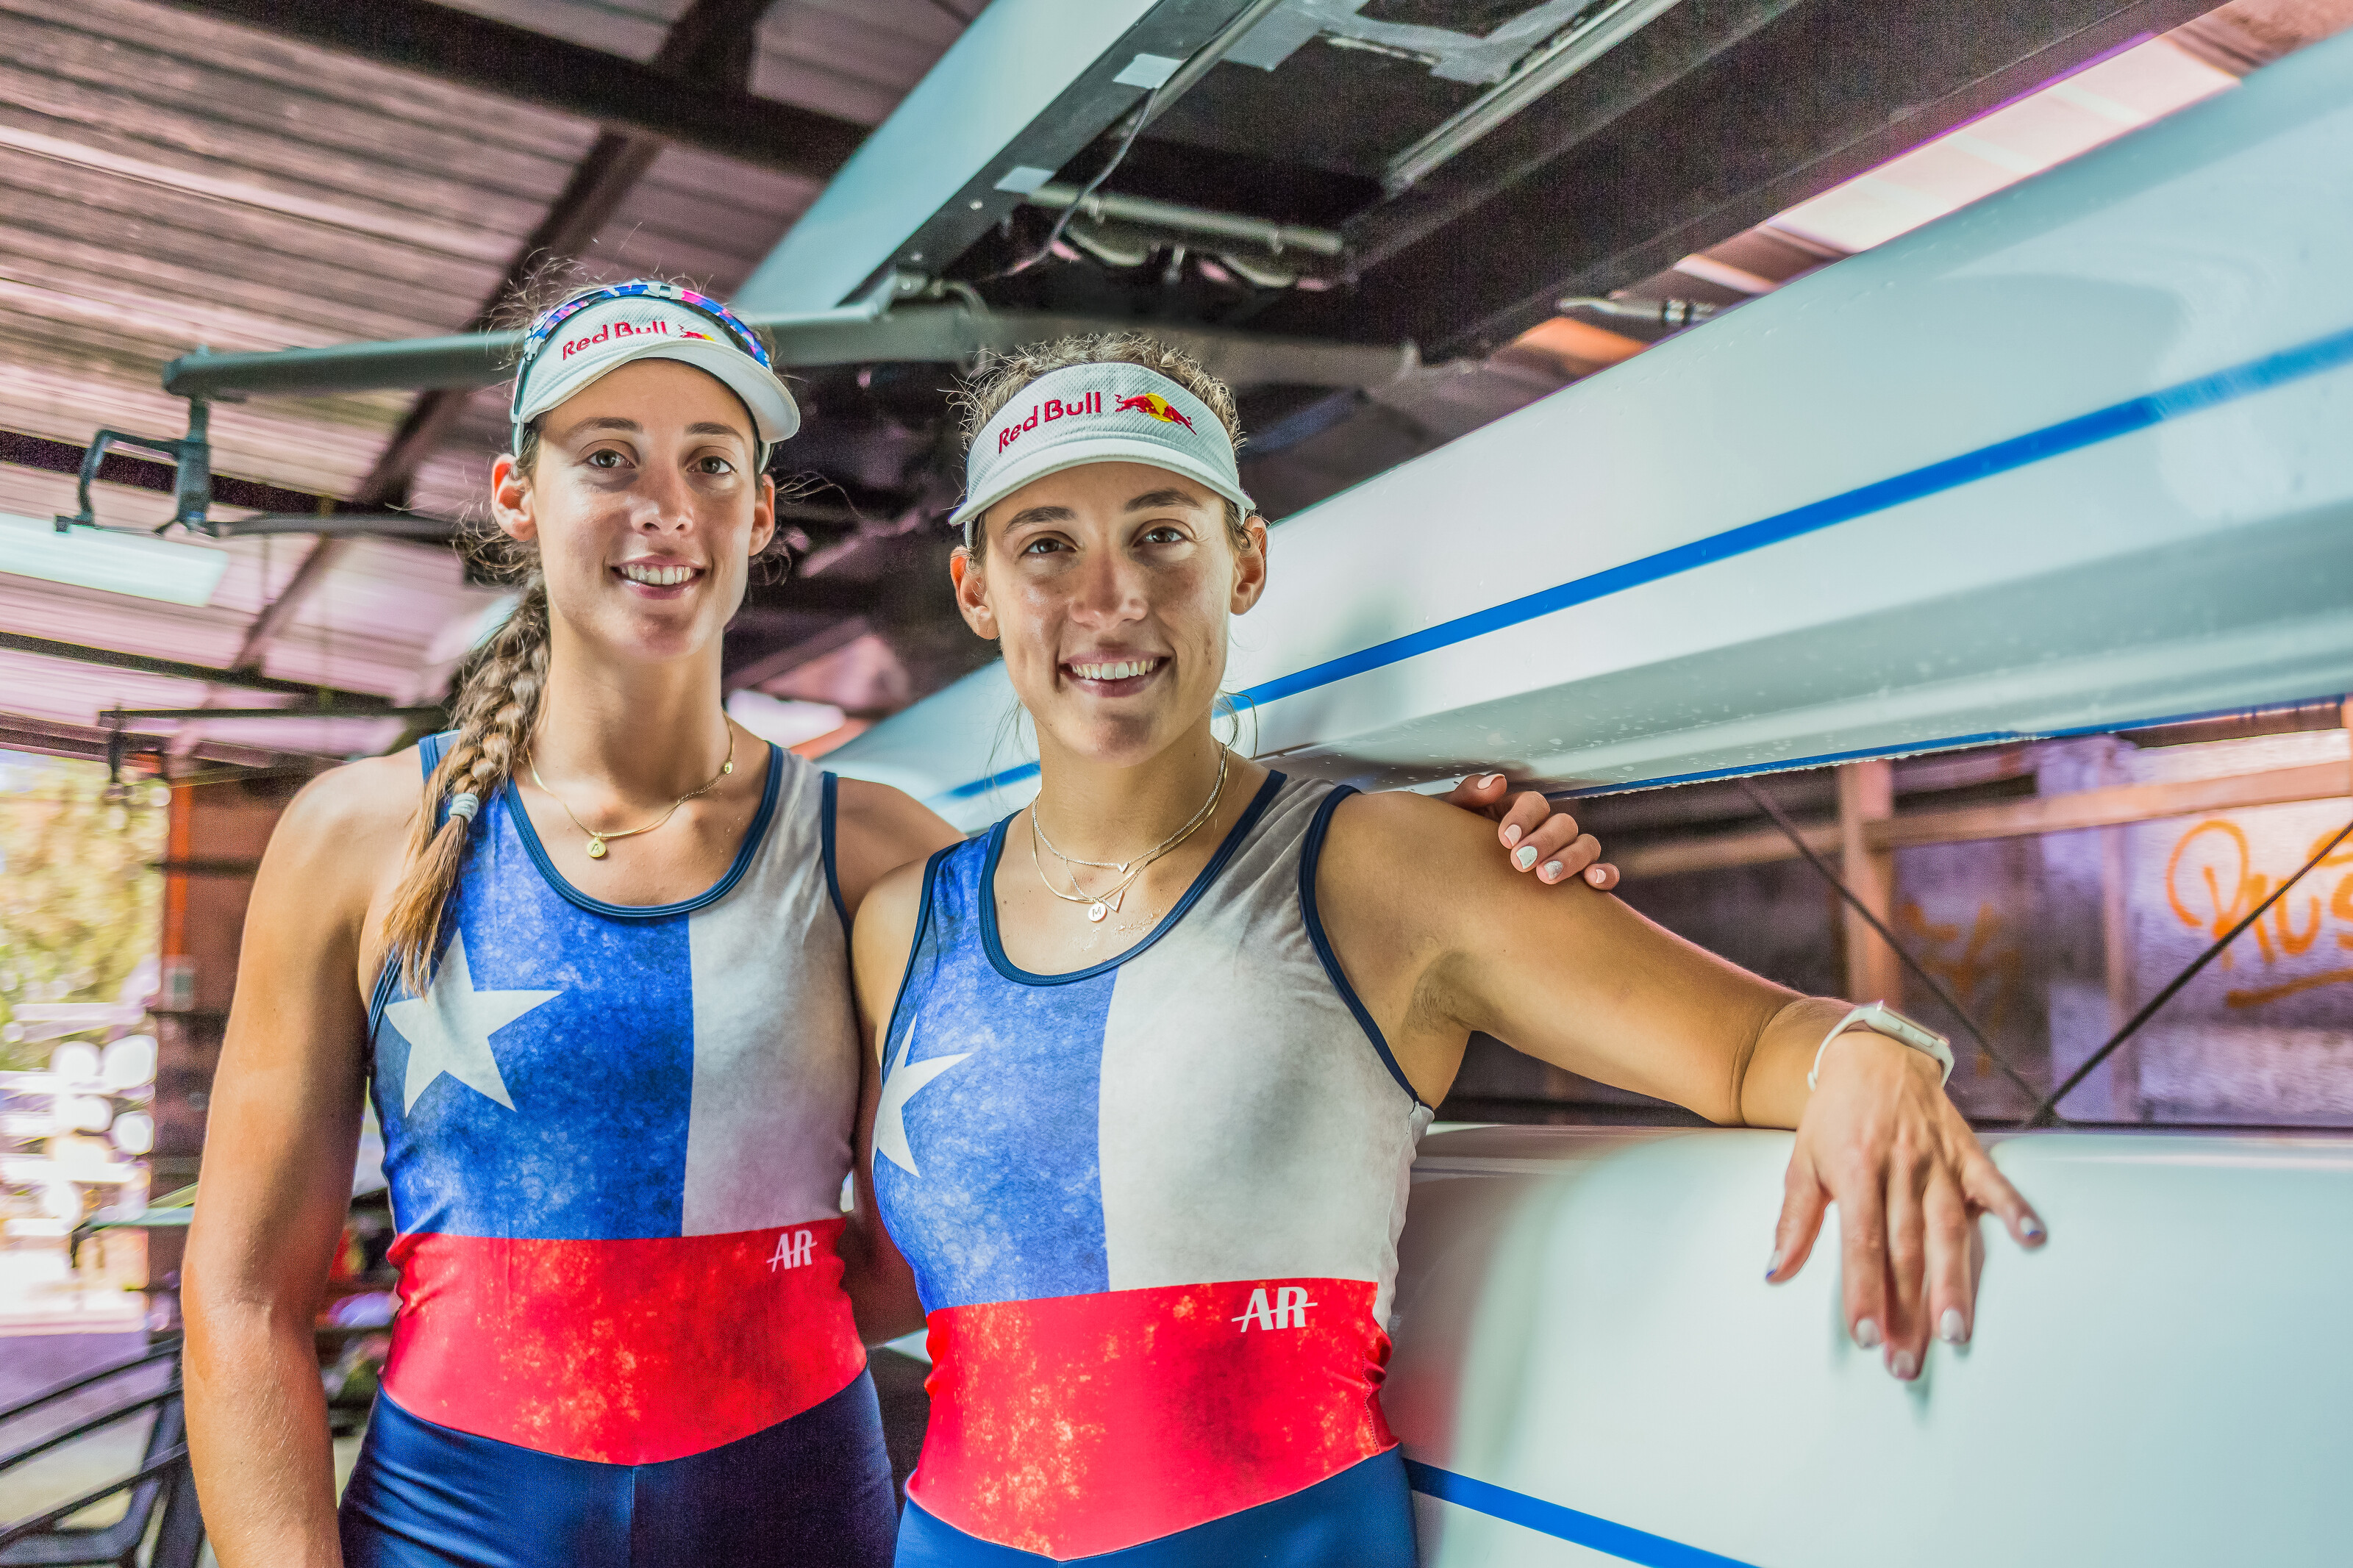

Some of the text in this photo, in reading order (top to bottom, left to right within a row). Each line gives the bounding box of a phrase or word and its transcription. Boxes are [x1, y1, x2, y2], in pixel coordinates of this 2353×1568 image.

[563, 321, 668, 360] Red Bull
[998, 391, 1101, 454] Red Bull
[767, 1229, 818, 1272] AR
[1231, 1286, 1318, 1333] AR
